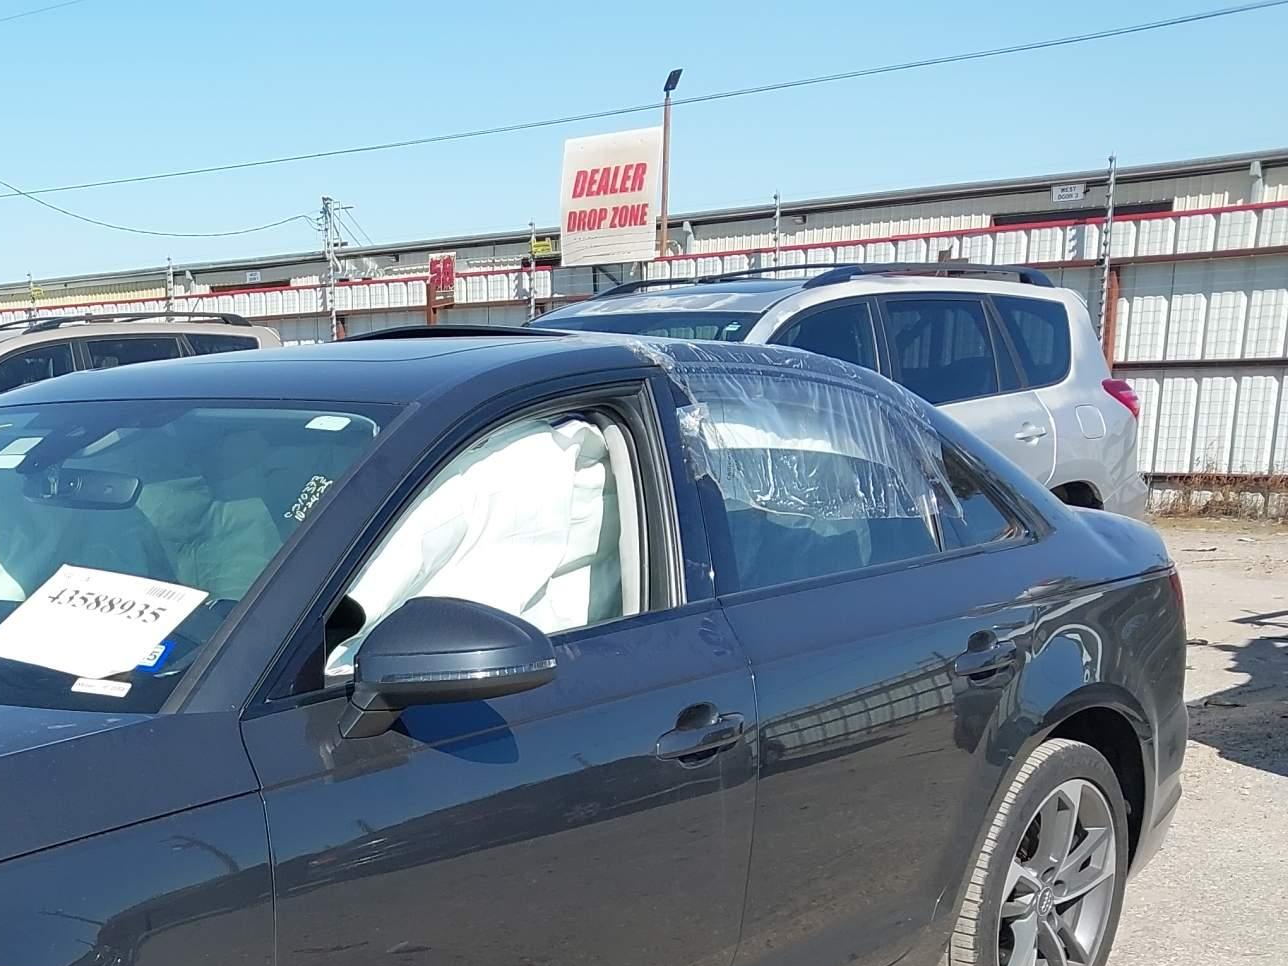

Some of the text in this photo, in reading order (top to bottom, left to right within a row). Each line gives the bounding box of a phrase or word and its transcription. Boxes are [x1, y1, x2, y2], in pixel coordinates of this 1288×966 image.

[571, 162, 647, 199] DEALER
[566, 203, 649, 233] DROP ZONE
[48, 588, 168, 623] 43588935
